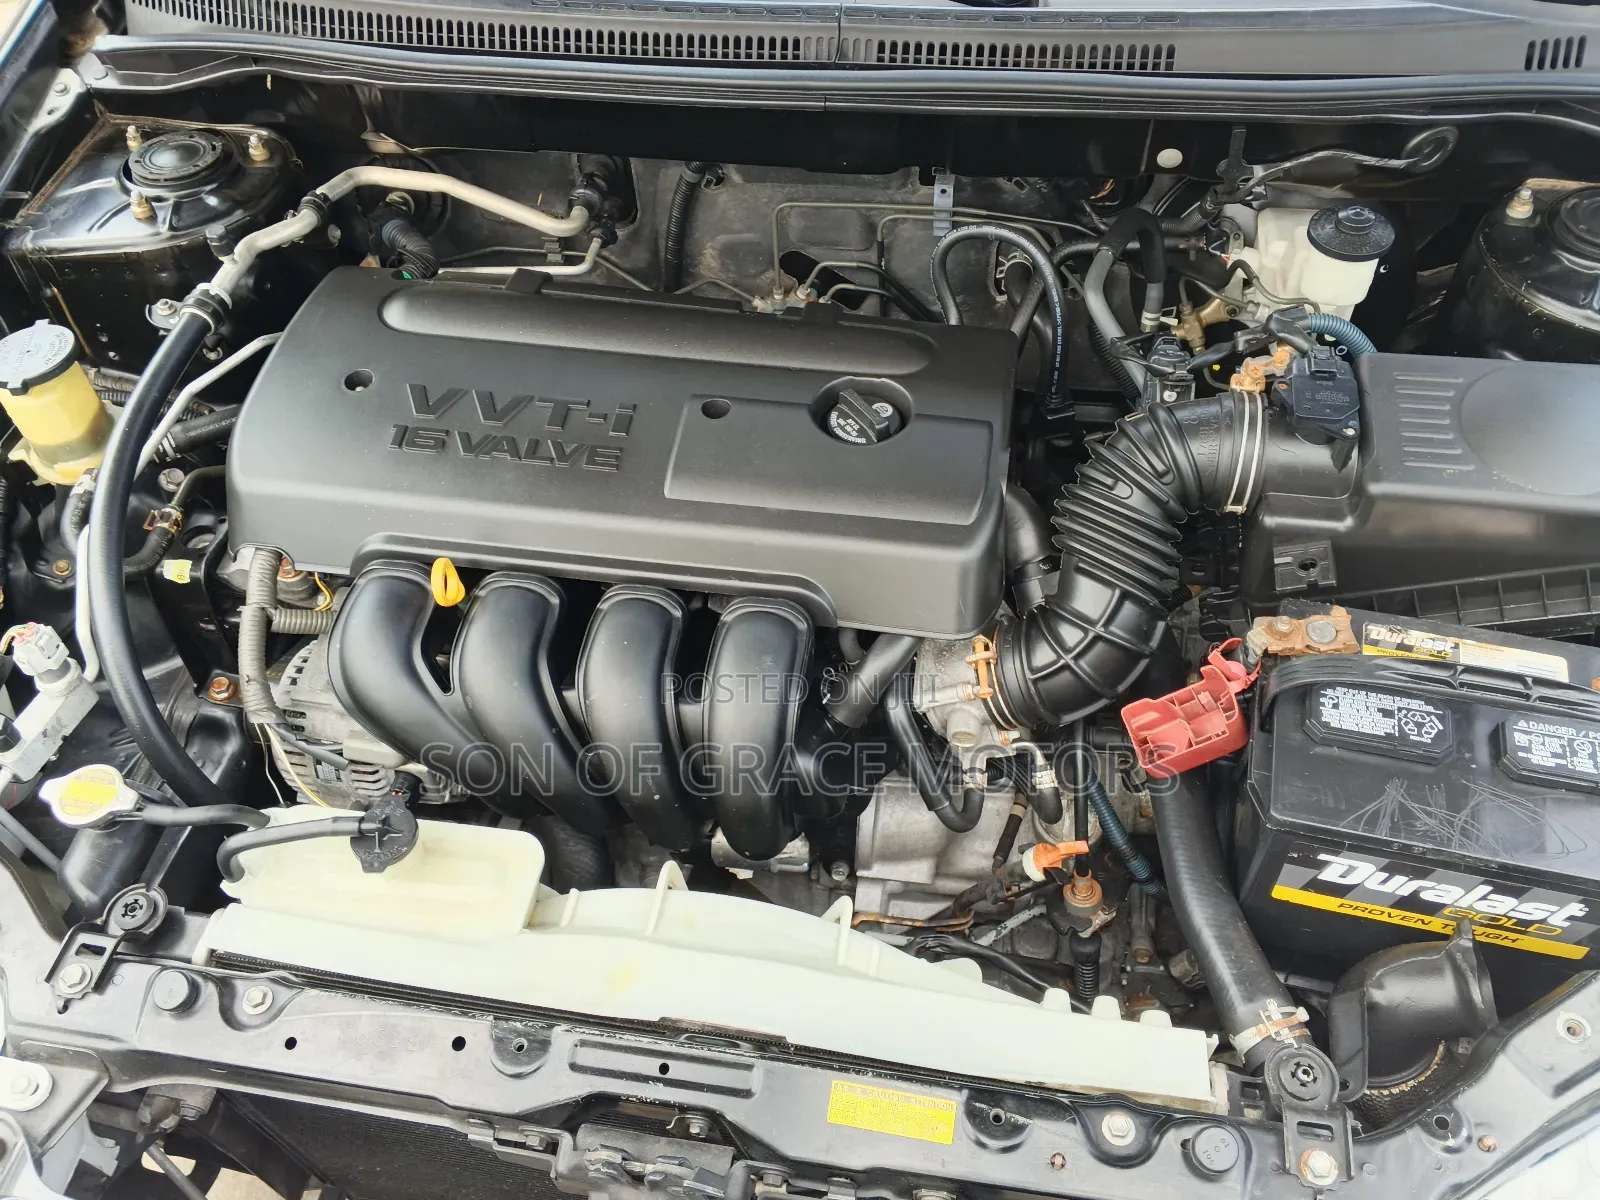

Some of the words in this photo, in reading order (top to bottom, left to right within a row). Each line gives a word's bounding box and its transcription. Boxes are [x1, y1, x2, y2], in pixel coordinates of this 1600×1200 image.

[388, 423, 449, 455] 16
[455, 430, 623, 473] VALVE
[1367, 625, 1455, 653] Duralast
[1529, 721, 1577, 736] DANGER
[1317, 853, 1588, 928] Duralast
[1337, 902, 1432, 926] PROVEN
[1441, 922, 1522, 944] TUGH
[1442, 907, 1563, 936] GOLD
